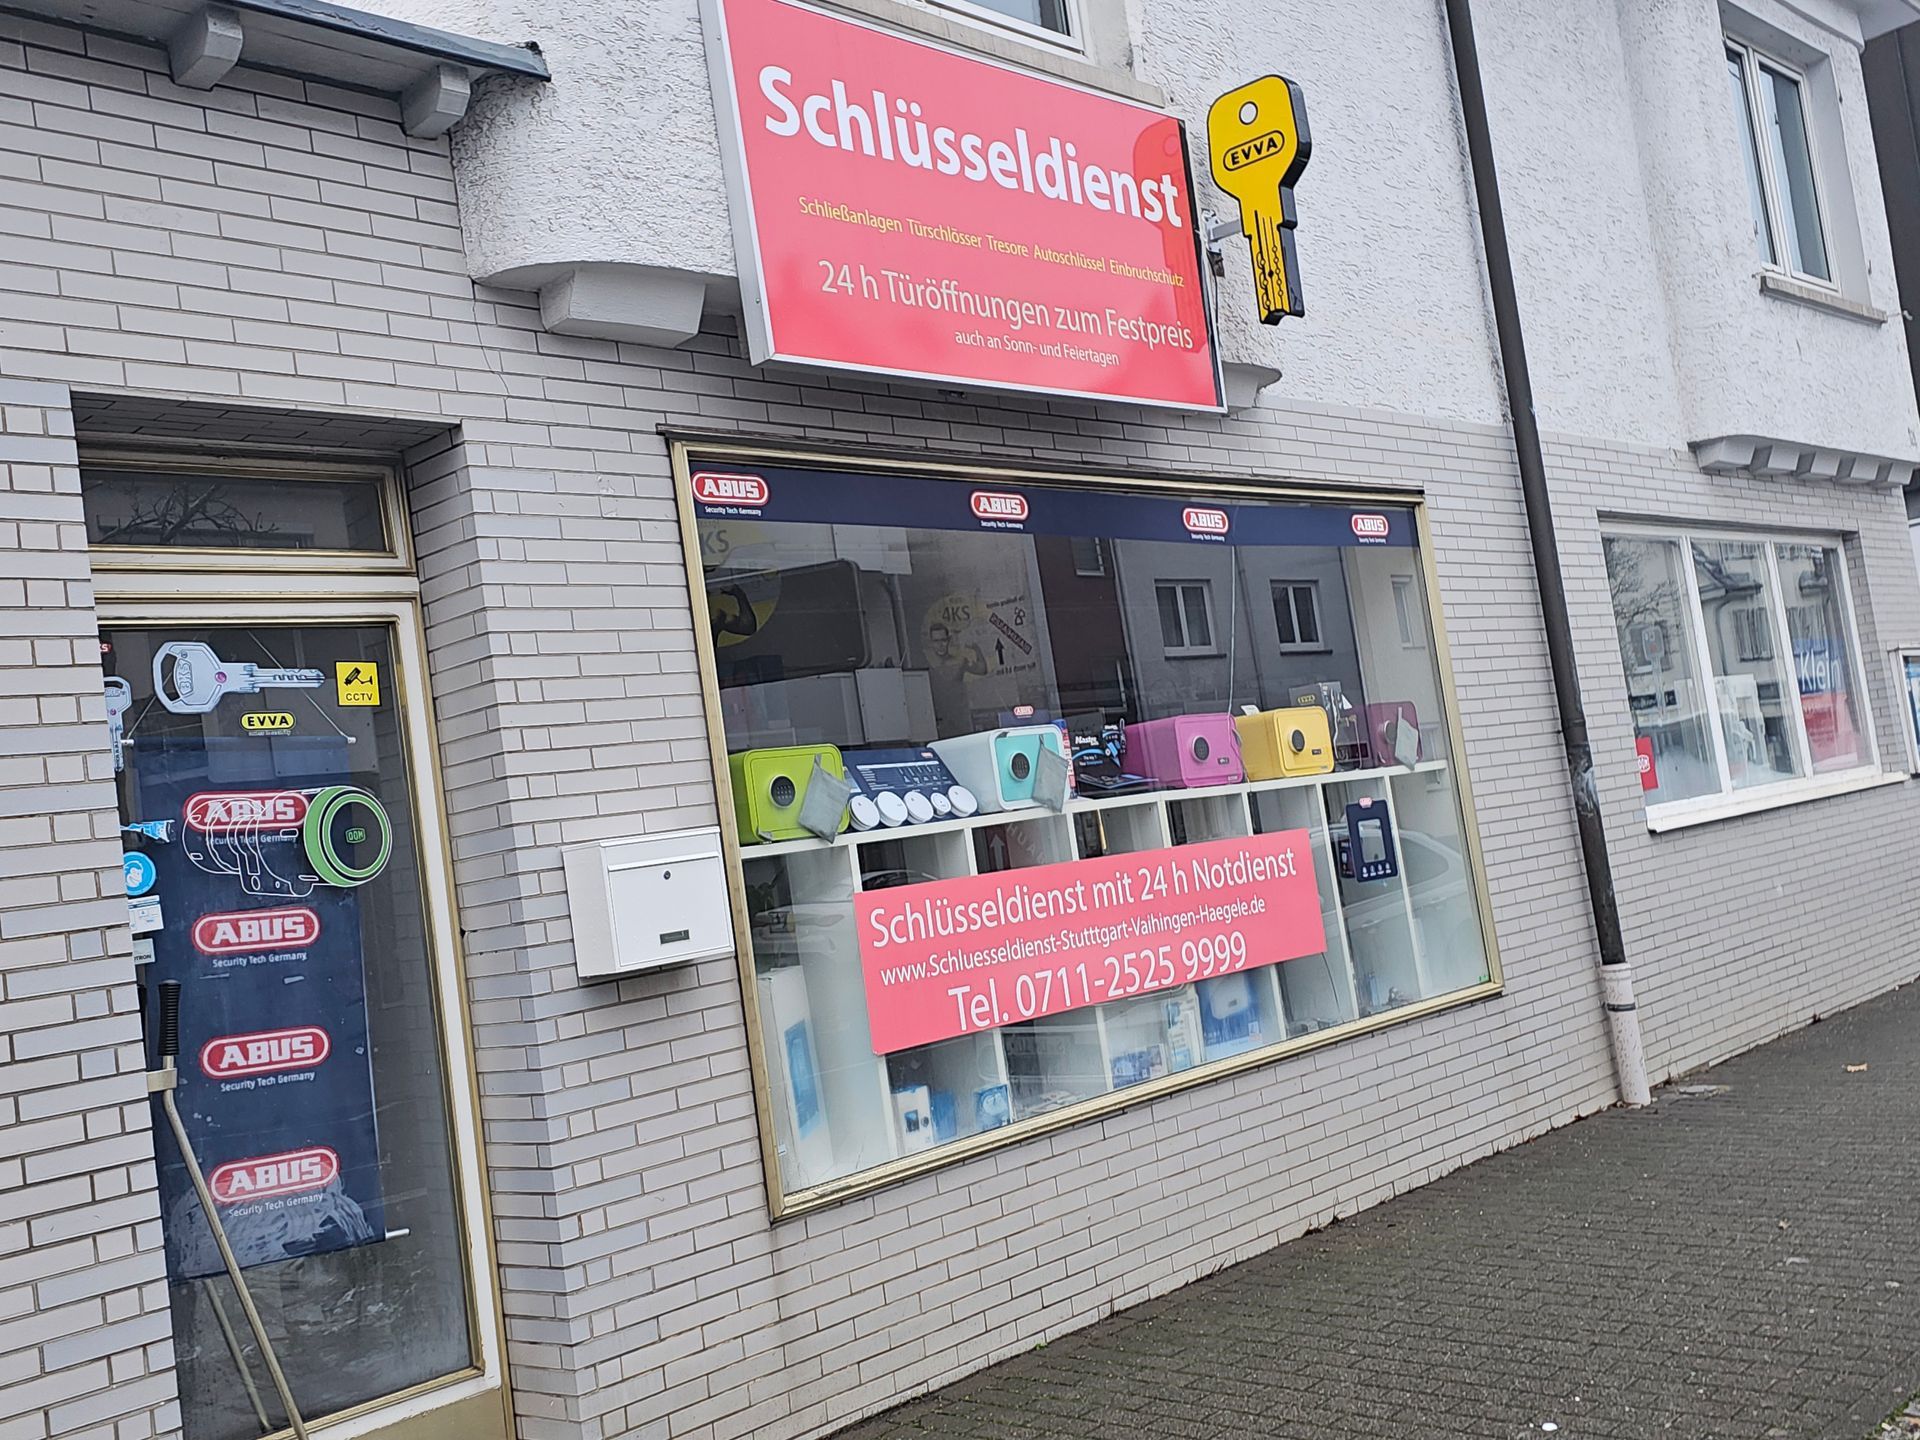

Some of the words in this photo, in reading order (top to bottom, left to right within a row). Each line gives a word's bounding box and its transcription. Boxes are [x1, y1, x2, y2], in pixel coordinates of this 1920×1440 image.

[759, 65, 1183, 228] Schlüsseldienst
[1230, 136, 1279, 166] EVVA
[799, 196, 904, 233] Schließanlagen
[905, 218, 983, 248] Türschlösser
[986, 234, 1030, 257] Tresore
[1033, 244, 1106, 272] Autoschlüssel
[1109, 259, 1185, 287] Einbruchschutz
[818, 260, 855, 296] 24
[859, 264, 880, 300] h
[881, 269, 1051, 331] Türöffnungen
[1054, 306, 1102, 336] zum
[1105, 307, 1194, 351] Festpreis
[955, 329, 985, 347] auch
[986, 335, 1002, 349] an
[1003, 335, 1038, 353] Sonn-
[1039, 342, 1063, 359] und
[1062, 345, 1120, 368] Feiertagen
[703, 478, 760, 498] ABUS
[979, 496, 1022, 514] ABUS
[1189, 512, 1224, 528] ABUS
[1357, 518, 1385, 531] ABUS
[700, 529, 729, 554] KS
[942, 606, 970, 622] 4KS
[1800, 648, 1841, 692] Klein
[346, 692, 373, 702] CCTV
[247, 715, 289, 727] EVVA
[205, 799, 296, 823] ABUS
[870, 880, 1088, 948] Schlüsseldienst
[1093, 871, 1135, 908] mit
[1138, 866, 1168, 900] 24
[1172, 861, 1189, 895] h
[1192, 848, 1297, 892] Notdienst
[212, 916, 305, 945] ABUS
[880, 894, 1266, 986] www.Schluesseldienst-Stutttgart-Vaihingen-Haegele.de
[212, 957, 247, 968] Security
[249, 955, 267, 964] Tech
[268, 951, 308, 963] Germany
[948, 978, 1009, 1031] Tel.
[1015, 945, 1175, 1017] 0711-2525
[1181, 931, 1247, 980] 9999
[220, 1035, 314, 1069] ABUS
[220, 1079, 256, 1092] Security
[257, 1076, 276, 1087] Tech
[277, 1071, 316, 1084] Germany
[228, 1156, 322, 1195] ABUS
[228, 1203, 263, 1218] Security
[265, 1199, 285, 1211] Tech
[286, 1192, 325, 1208] Germany
